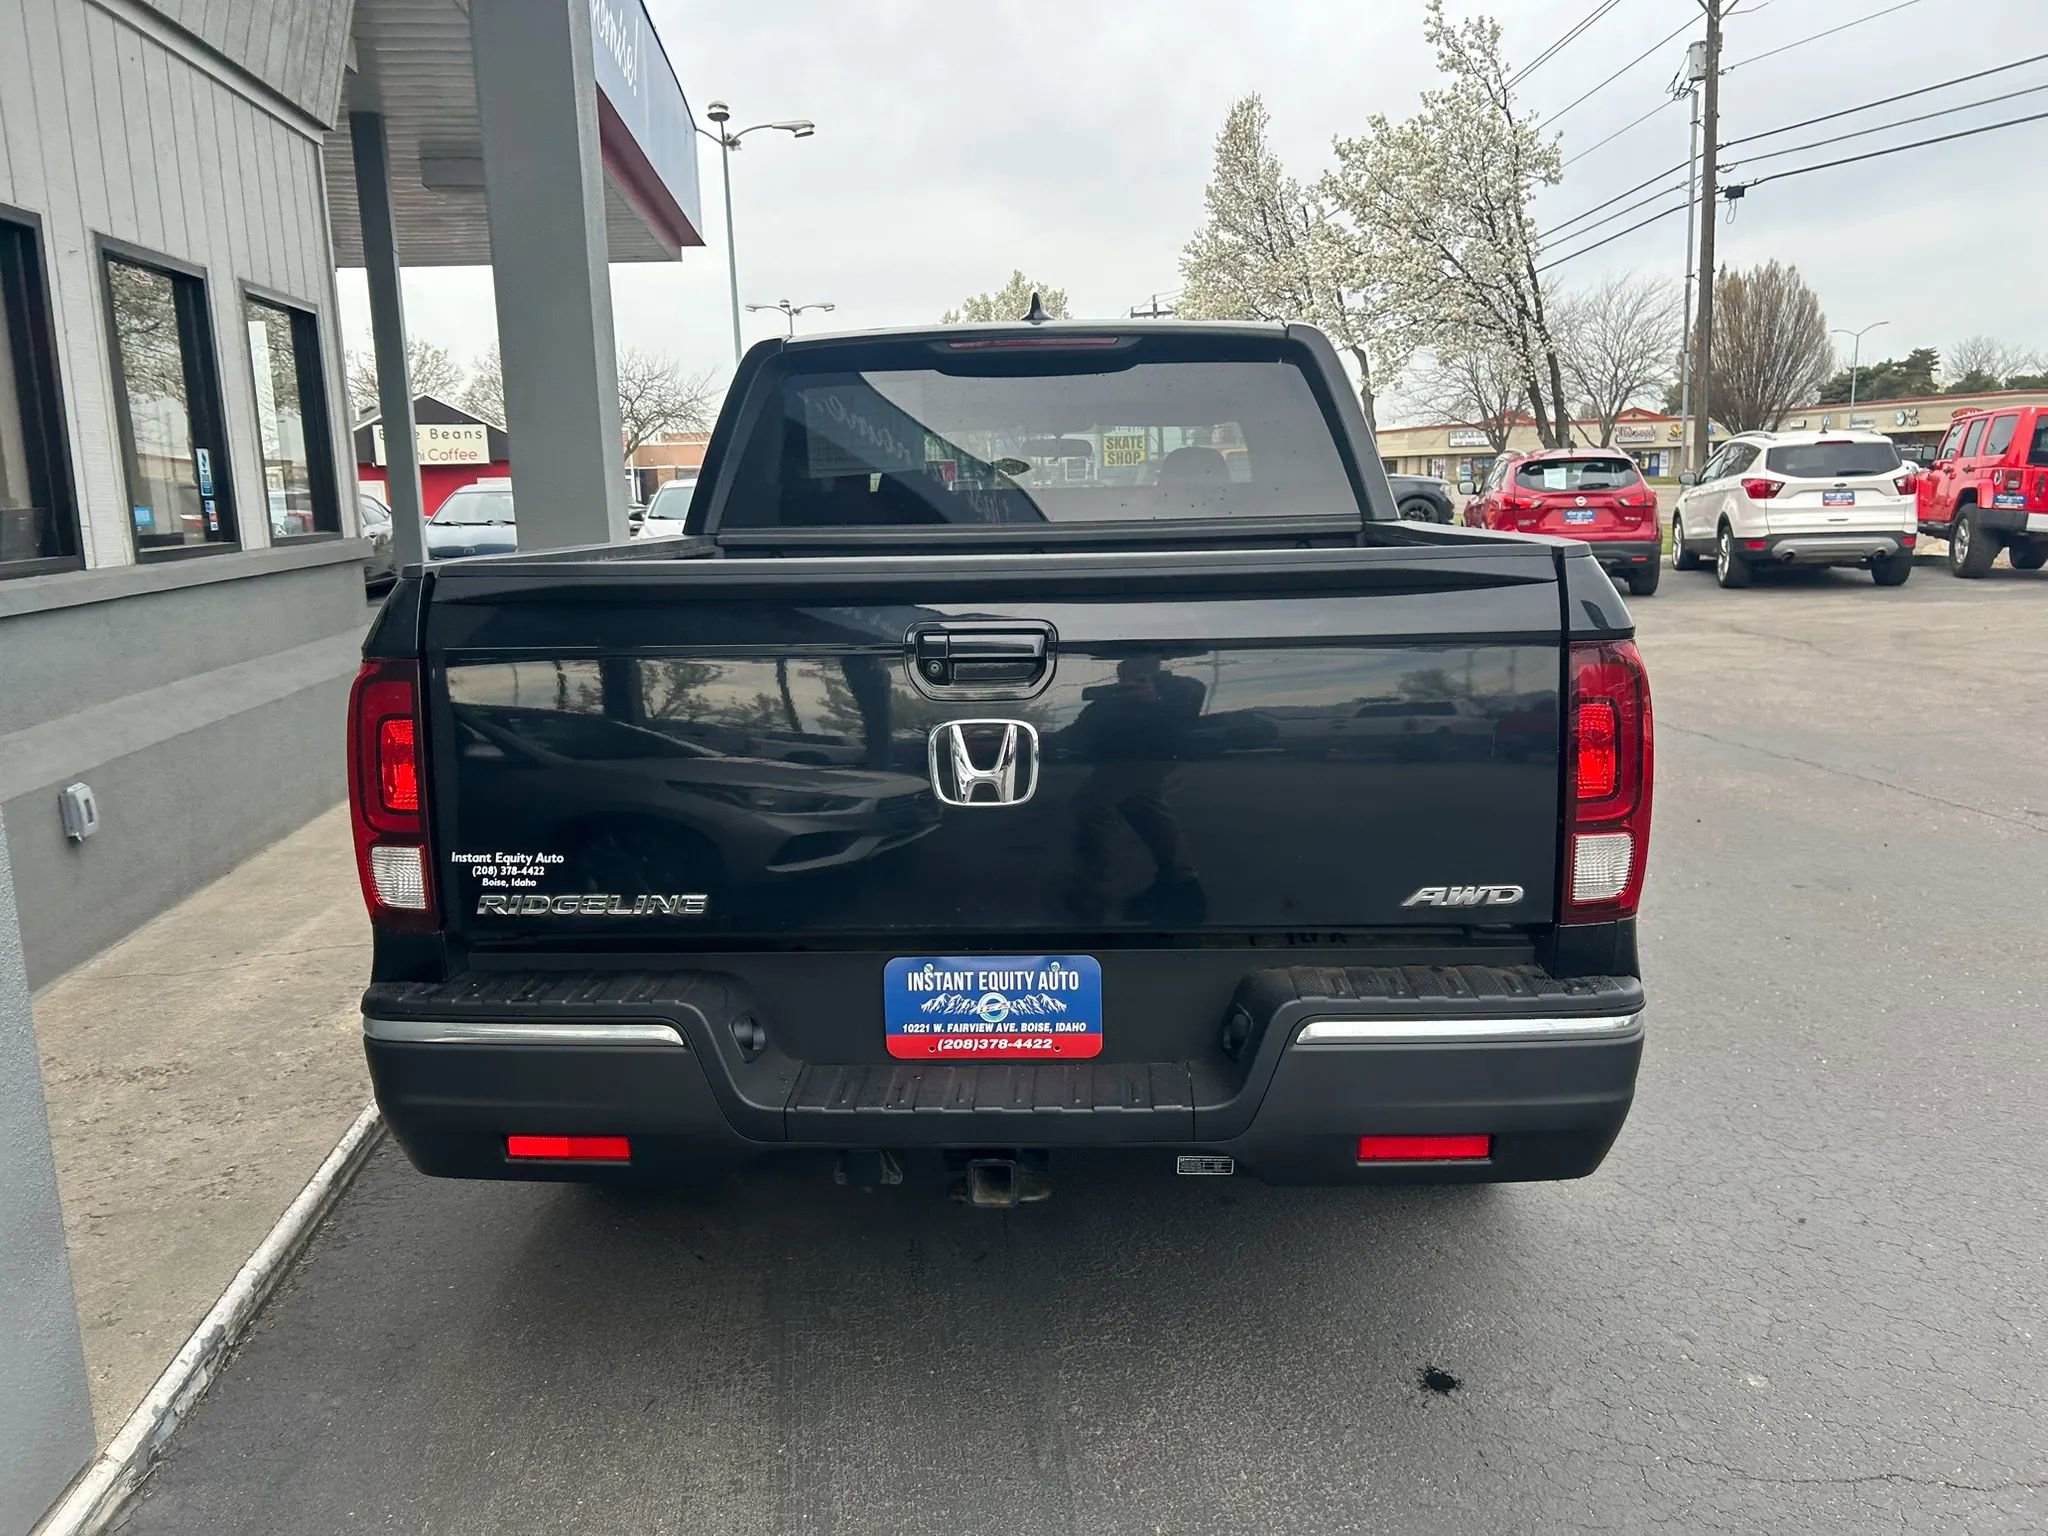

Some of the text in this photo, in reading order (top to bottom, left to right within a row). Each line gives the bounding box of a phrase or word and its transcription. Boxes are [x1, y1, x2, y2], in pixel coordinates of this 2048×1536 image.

[430, 428, 483, 440] Beans
[1106, 436, 1143, 450] SKATE
[428, 448, 478, 461] Coffee
[1107, 451, 1141, 465] SHOP
[451, 851, 565, 866] Instant Equity Auto
[472, 865, 545, 877] (208) 378-4422
[481, 877, 537, 888] Boise, Idaho
[1401, 884, 1524, 907] AWD
[476, 894, 708, 916] RIDGELINE
[907, 970, 1079, 992] INSTANT EQUITY AUTO
[902, 1022, 1087, 1034] 10221 W. FAIRVIEW AVE. BOISE, IDAHO
[937, 1038, 1053, 1052] (208)378-4422
